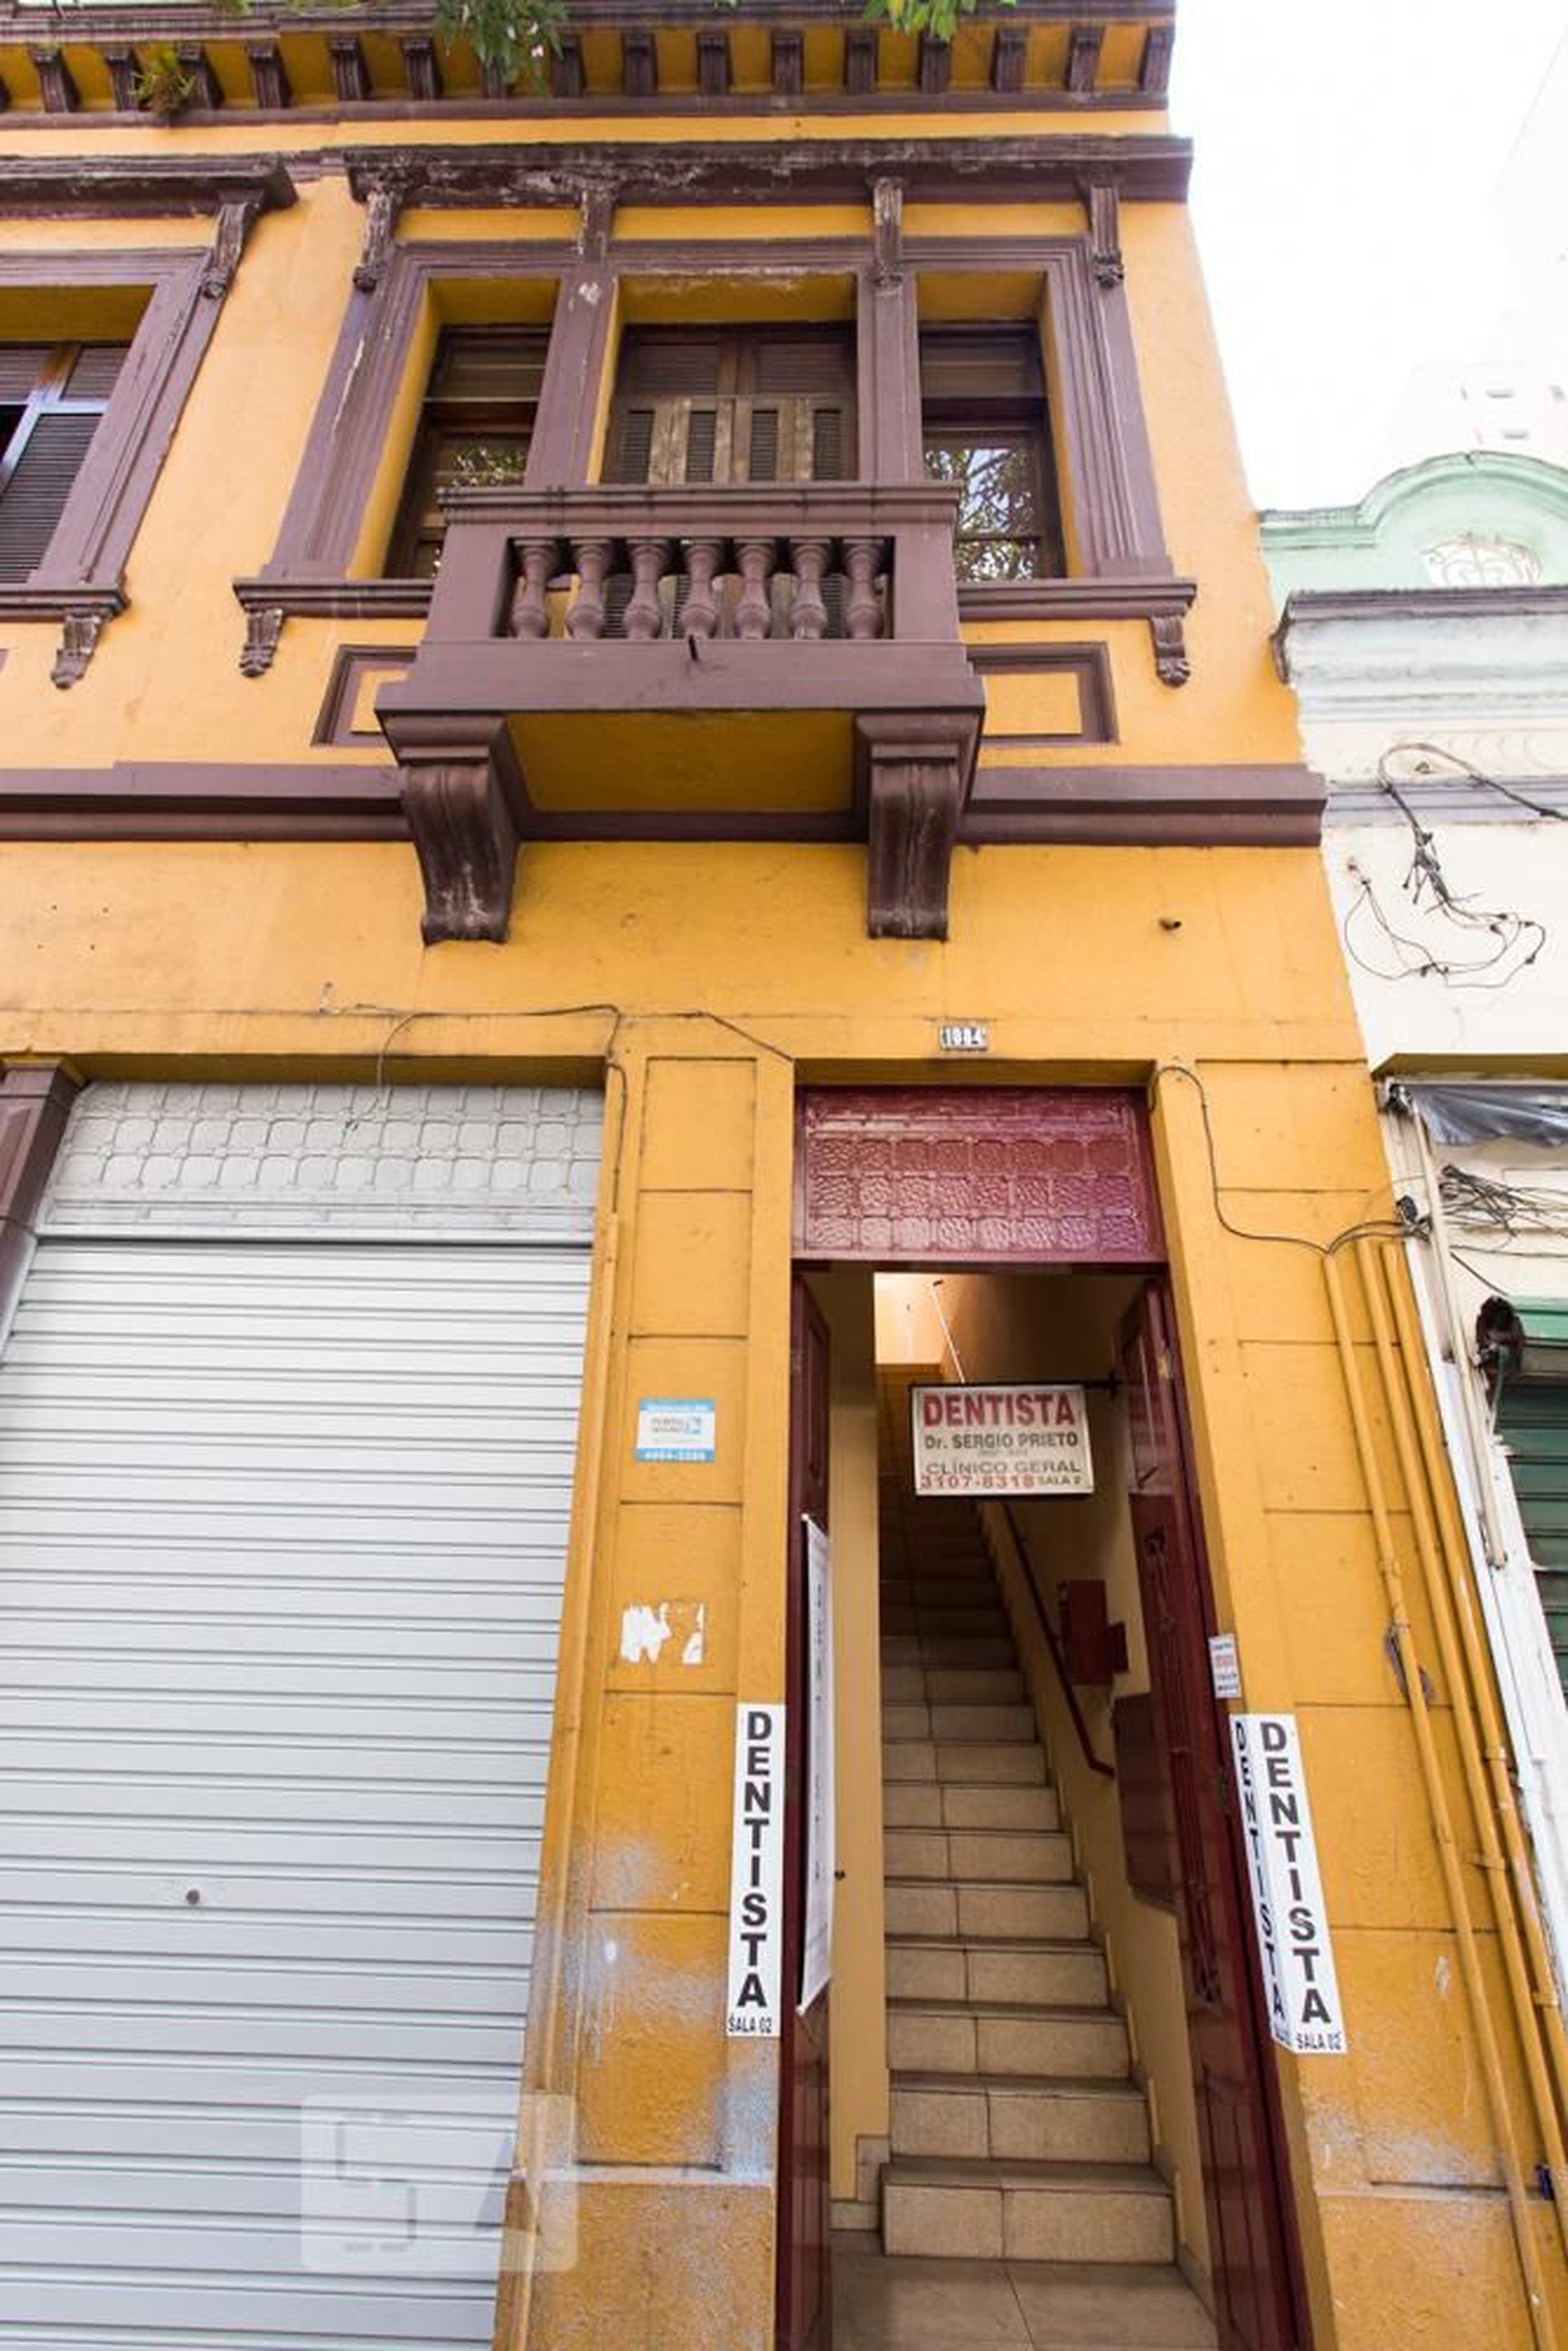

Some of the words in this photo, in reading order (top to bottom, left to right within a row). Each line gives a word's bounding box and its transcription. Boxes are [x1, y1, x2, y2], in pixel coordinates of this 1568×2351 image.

[924, 1393, 1075, 1426] DENTISTA
[925, 1434, 948, 1449] Dr.
[1018, 1431, 1078, 1447] PRIETO
[1015, 1460, 1081, 1473] GERAL
[921, 1474, 1035, 1489] 3107-8318
[737, 1711, 772, 2007] DENTISTA
[1236, 1721, 1286, 2021] DENTISTA
[1260, 1721, 1331, 2023] DENTISTA
[728, 2014, 755, 2032] SALA
[759, 2015, 772, 2033] 02
[1296, 2032, 1326, 2050] SALA
